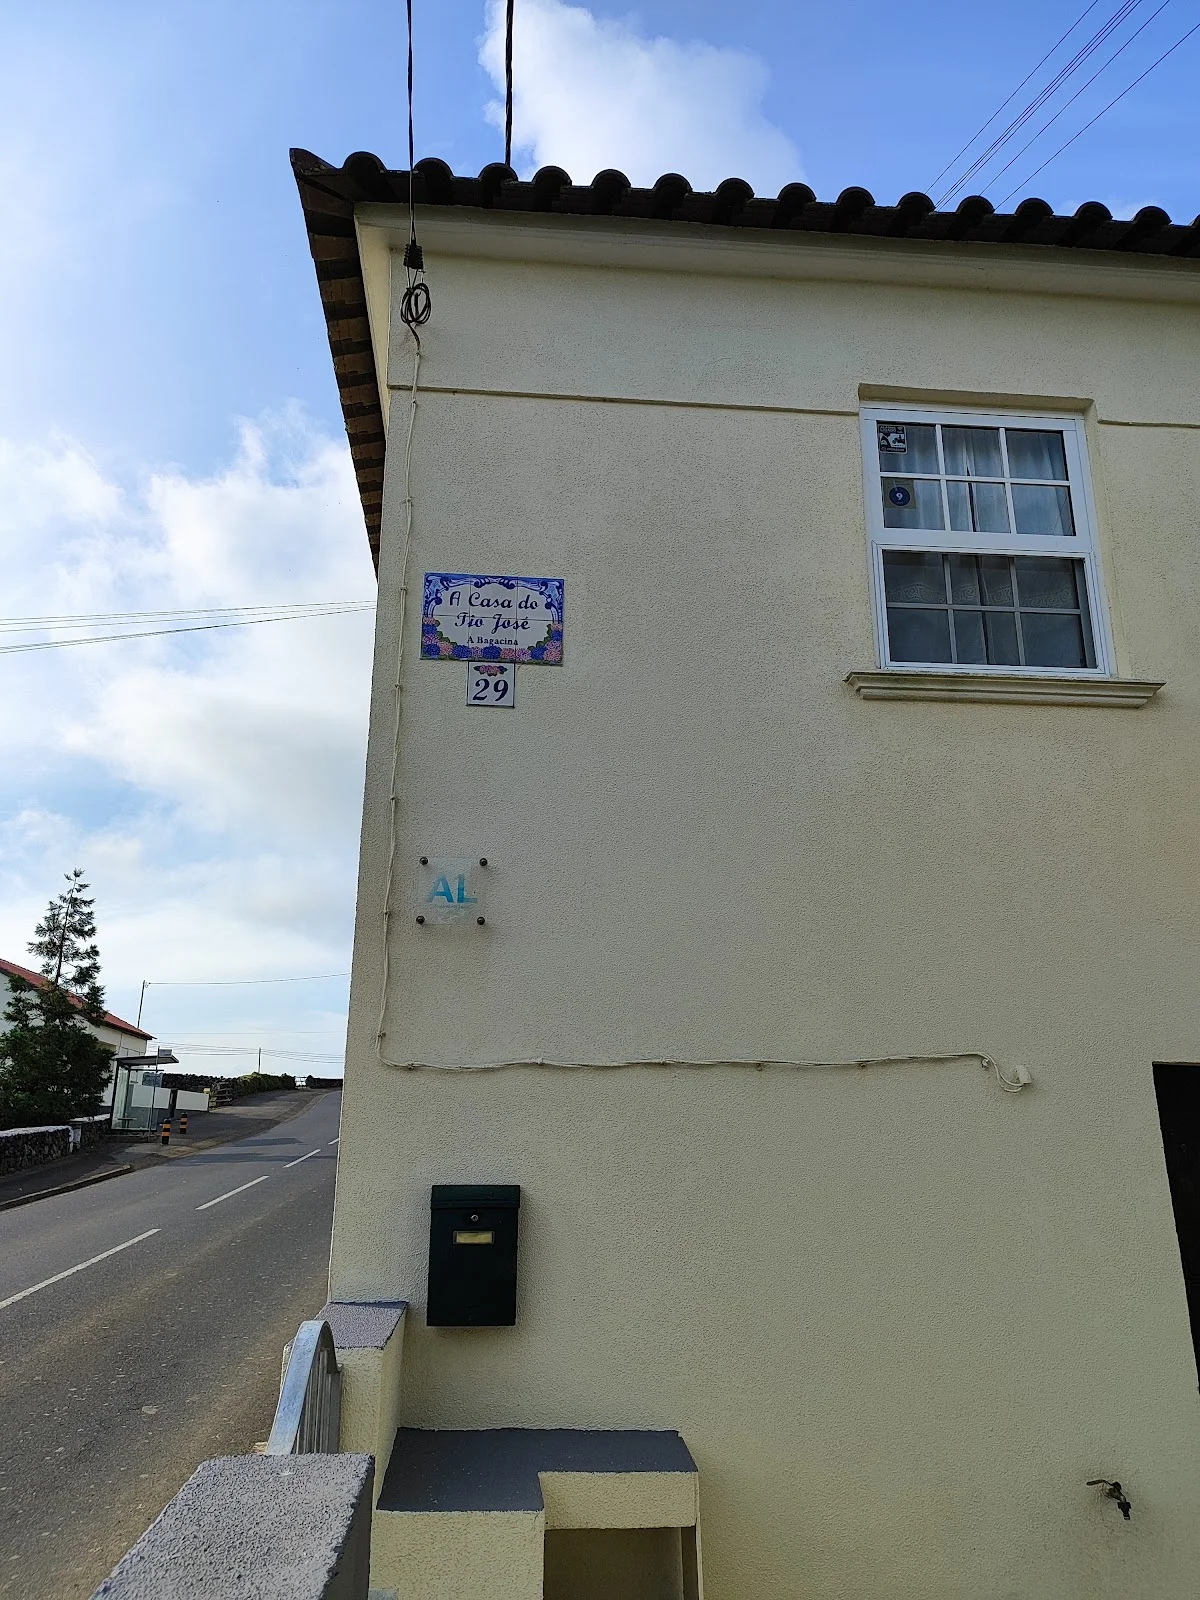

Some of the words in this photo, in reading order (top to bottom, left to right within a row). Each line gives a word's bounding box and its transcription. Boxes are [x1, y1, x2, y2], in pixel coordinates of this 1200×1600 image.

[896, 492, 903, 500] 9
[449, 591, 461, 607] A
[468, 591, 513, 609] Casa
[518, 594, 540, 610] do
[454, 612, 485, 628] Tio
[491, 613, 531, 635] José
[477, 636, 518, 646] Bagacina
[472, 678, 509, 702] 29
[427, 873, 478, 904] AL
